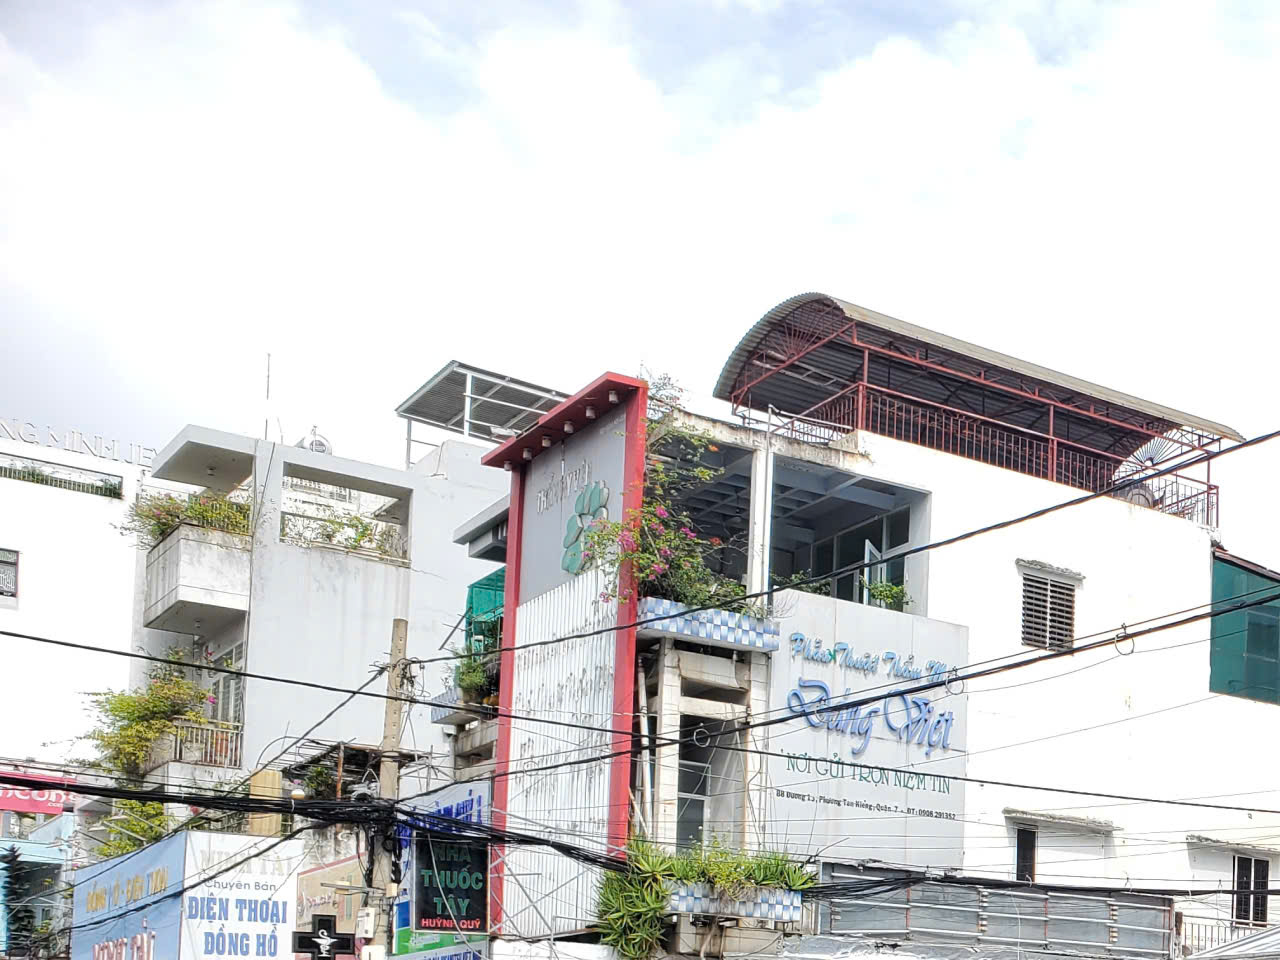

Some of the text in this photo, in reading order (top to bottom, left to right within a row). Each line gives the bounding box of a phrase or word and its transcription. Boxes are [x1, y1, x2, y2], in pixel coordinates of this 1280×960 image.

[926, 660, 955, 684] M
[204, 879, 277, 891] Chuyên Bán
[420, 864, 484, 890] THUỐC
[188, 892, 229, 923] ĐIỆN
[235, 898, 288, 926] THOẠI
[433, 894, 471, 916] TÂY
[204, 922, 278, 957] ĐỒNG HỒ
